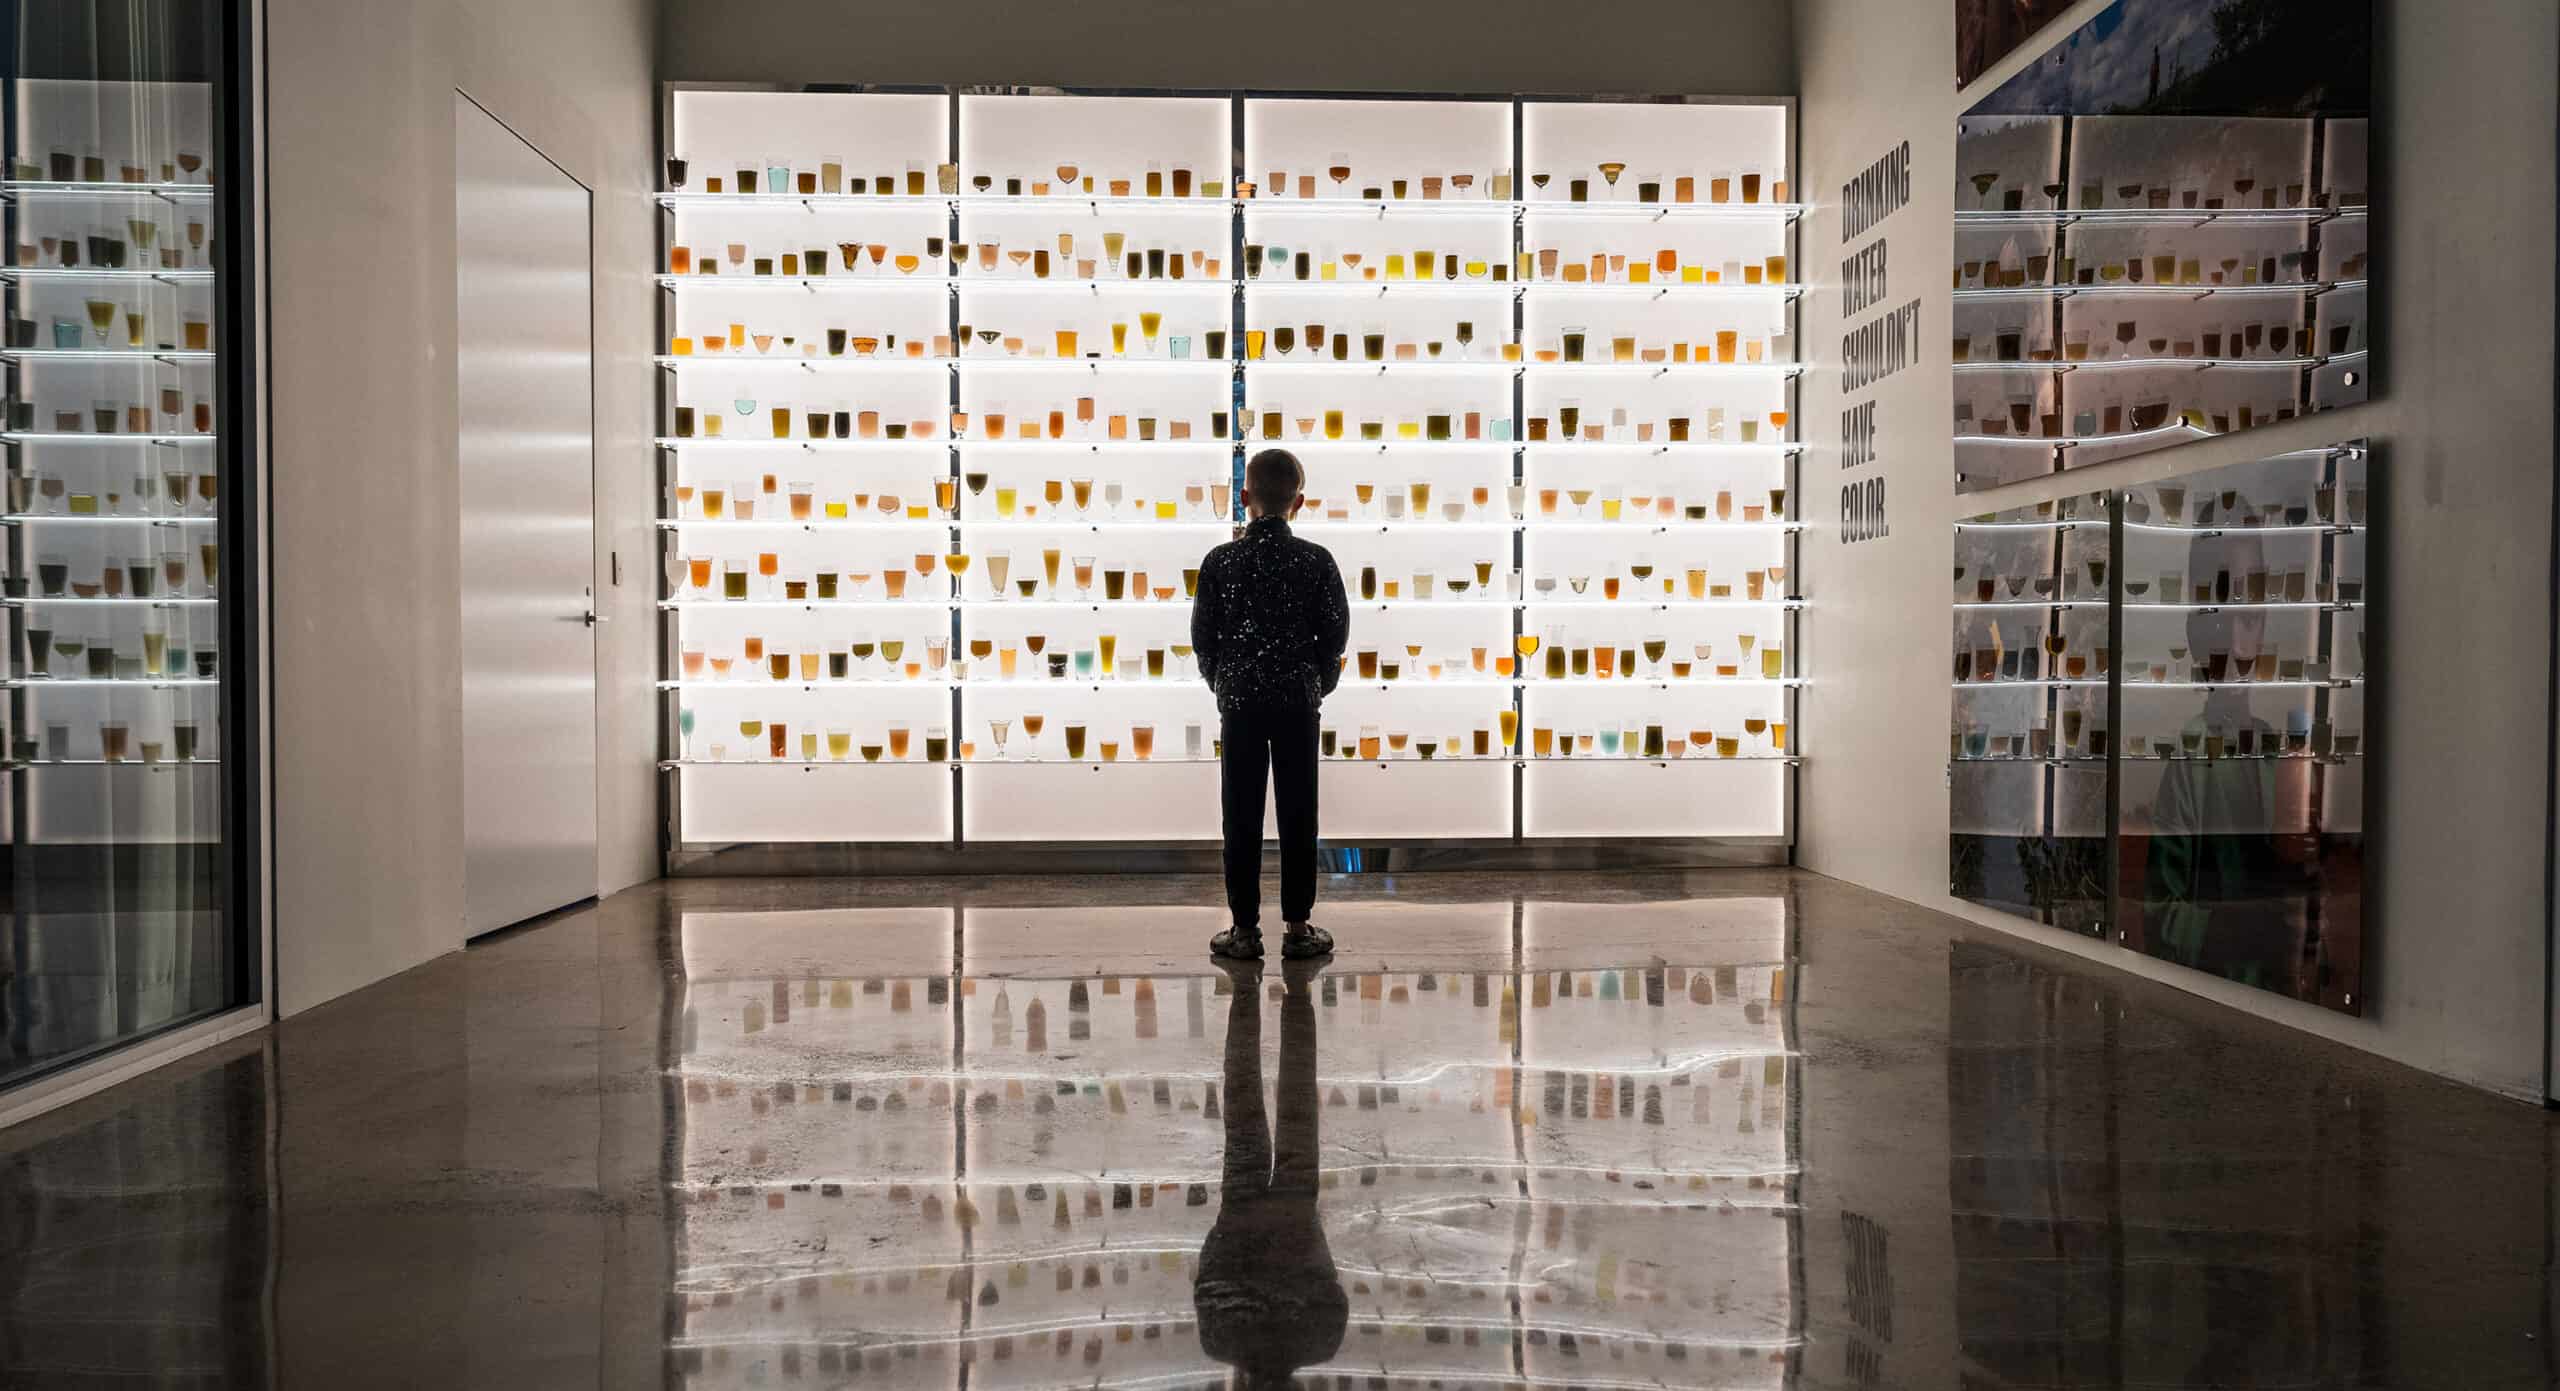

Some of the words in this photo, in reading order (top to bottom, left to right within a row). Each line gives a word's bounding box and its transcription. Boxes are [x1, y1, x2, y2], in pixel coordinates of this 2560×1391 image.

[1842, 140, 1911, 244] DRINKING
[1842, 238, 1887, 318] WATER
[1842, 298, 1921, 394] SHOULDN'T
[1841, 400, 1876, 469] HAVE
[1841, 477, 1889, 544] COLOR.
